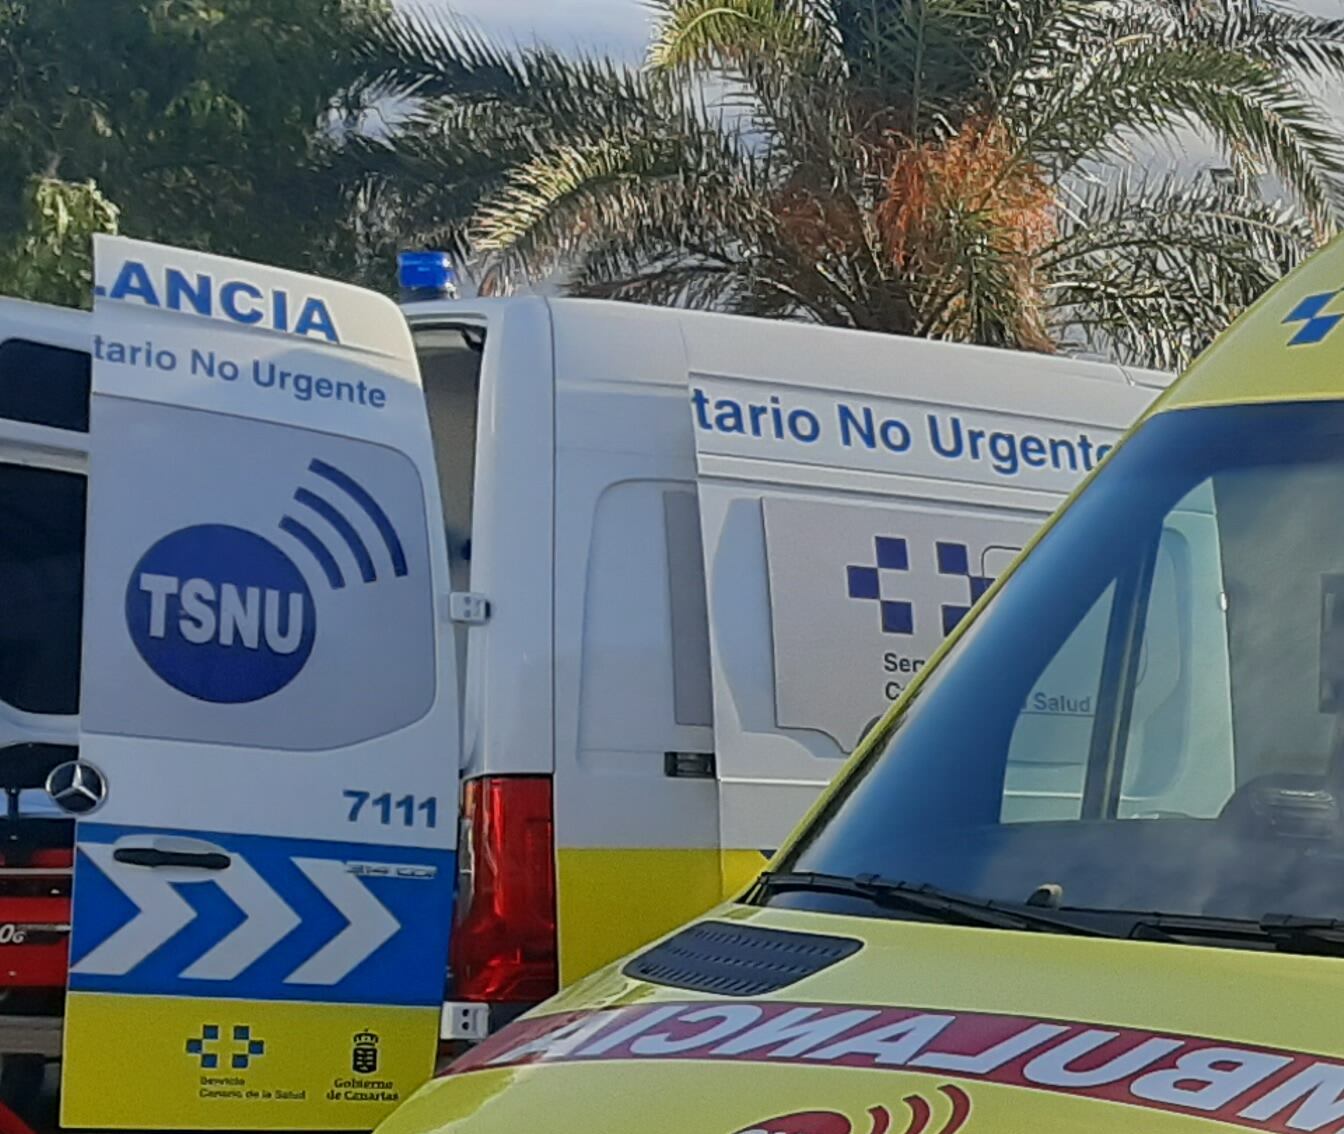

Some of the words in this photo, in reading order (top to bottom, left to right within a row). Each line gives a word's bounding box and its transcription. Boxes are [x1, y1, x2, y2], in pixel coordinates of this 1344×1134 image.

[94, 260, 341, 345] ANCIA
[93, 335, 177, 372] tario
[190, 349, 240, 382] No
[252, 359, 387, 409] Urgente
[690, 387, 821, 443] tario
[837, 403, 912, 453] No
[138, 572, 303, 655] TSNU
[884, 652, 926, 673] Ser
[1033, 691, 1091, 713] Salud
[342, 788, 438, 829] 7111
[326, 1089, 342, 1100] de
[333, 1077, 394, 1089] Gobierno
